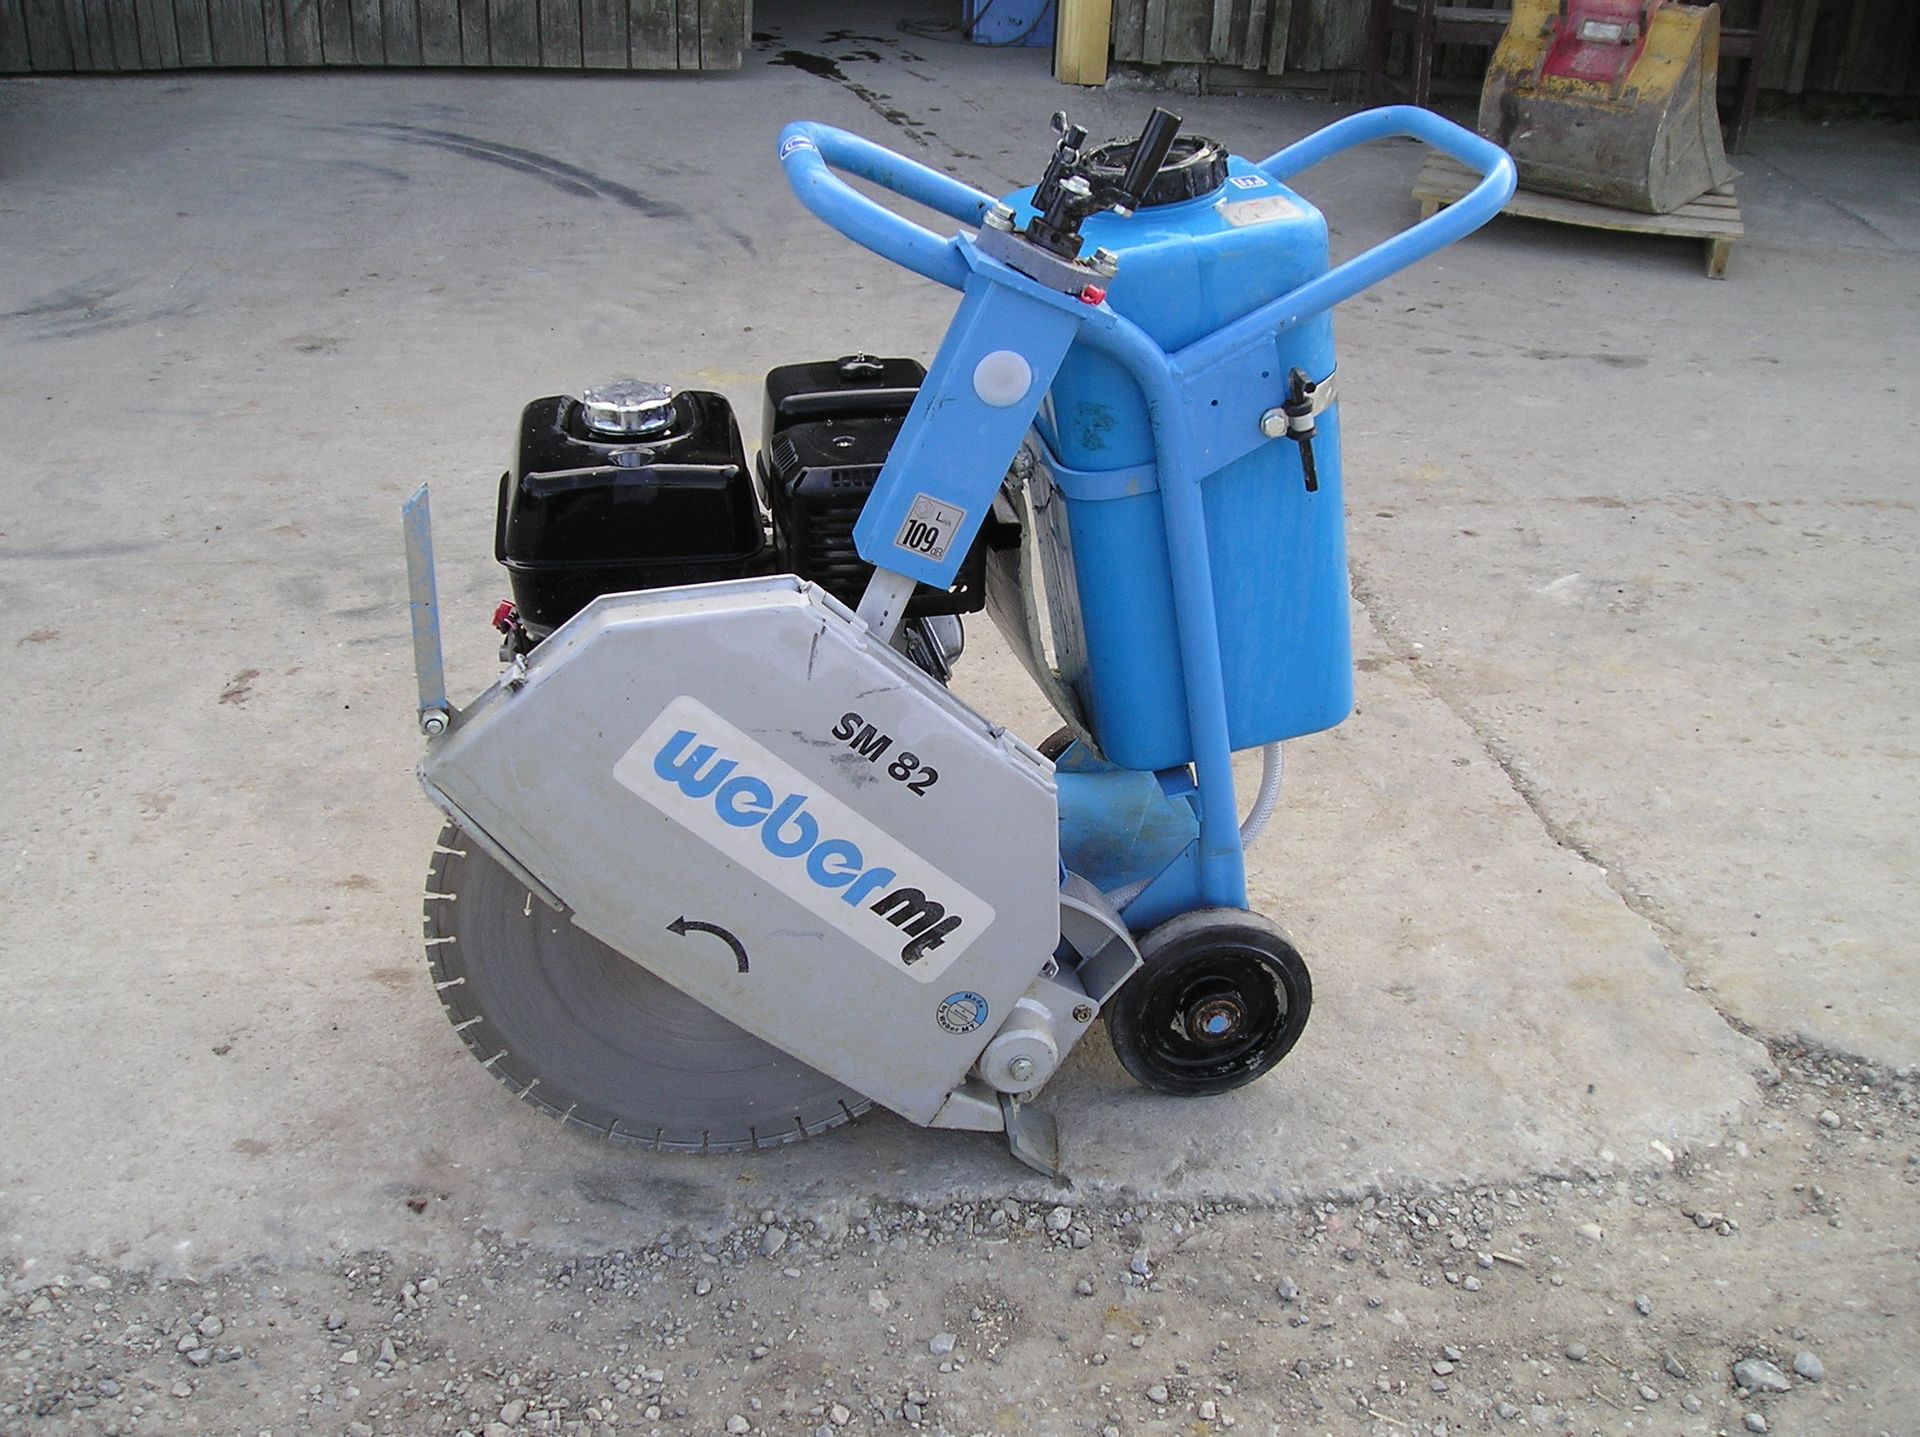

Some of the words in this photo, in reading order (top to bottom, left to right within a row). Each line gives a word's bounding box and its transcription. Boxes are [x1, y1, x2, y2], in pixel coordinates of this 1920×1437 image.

[903, 519, 939, 553] 109
[831, 712, 893, 763] SM
[887, 751, 939, 797] 82
